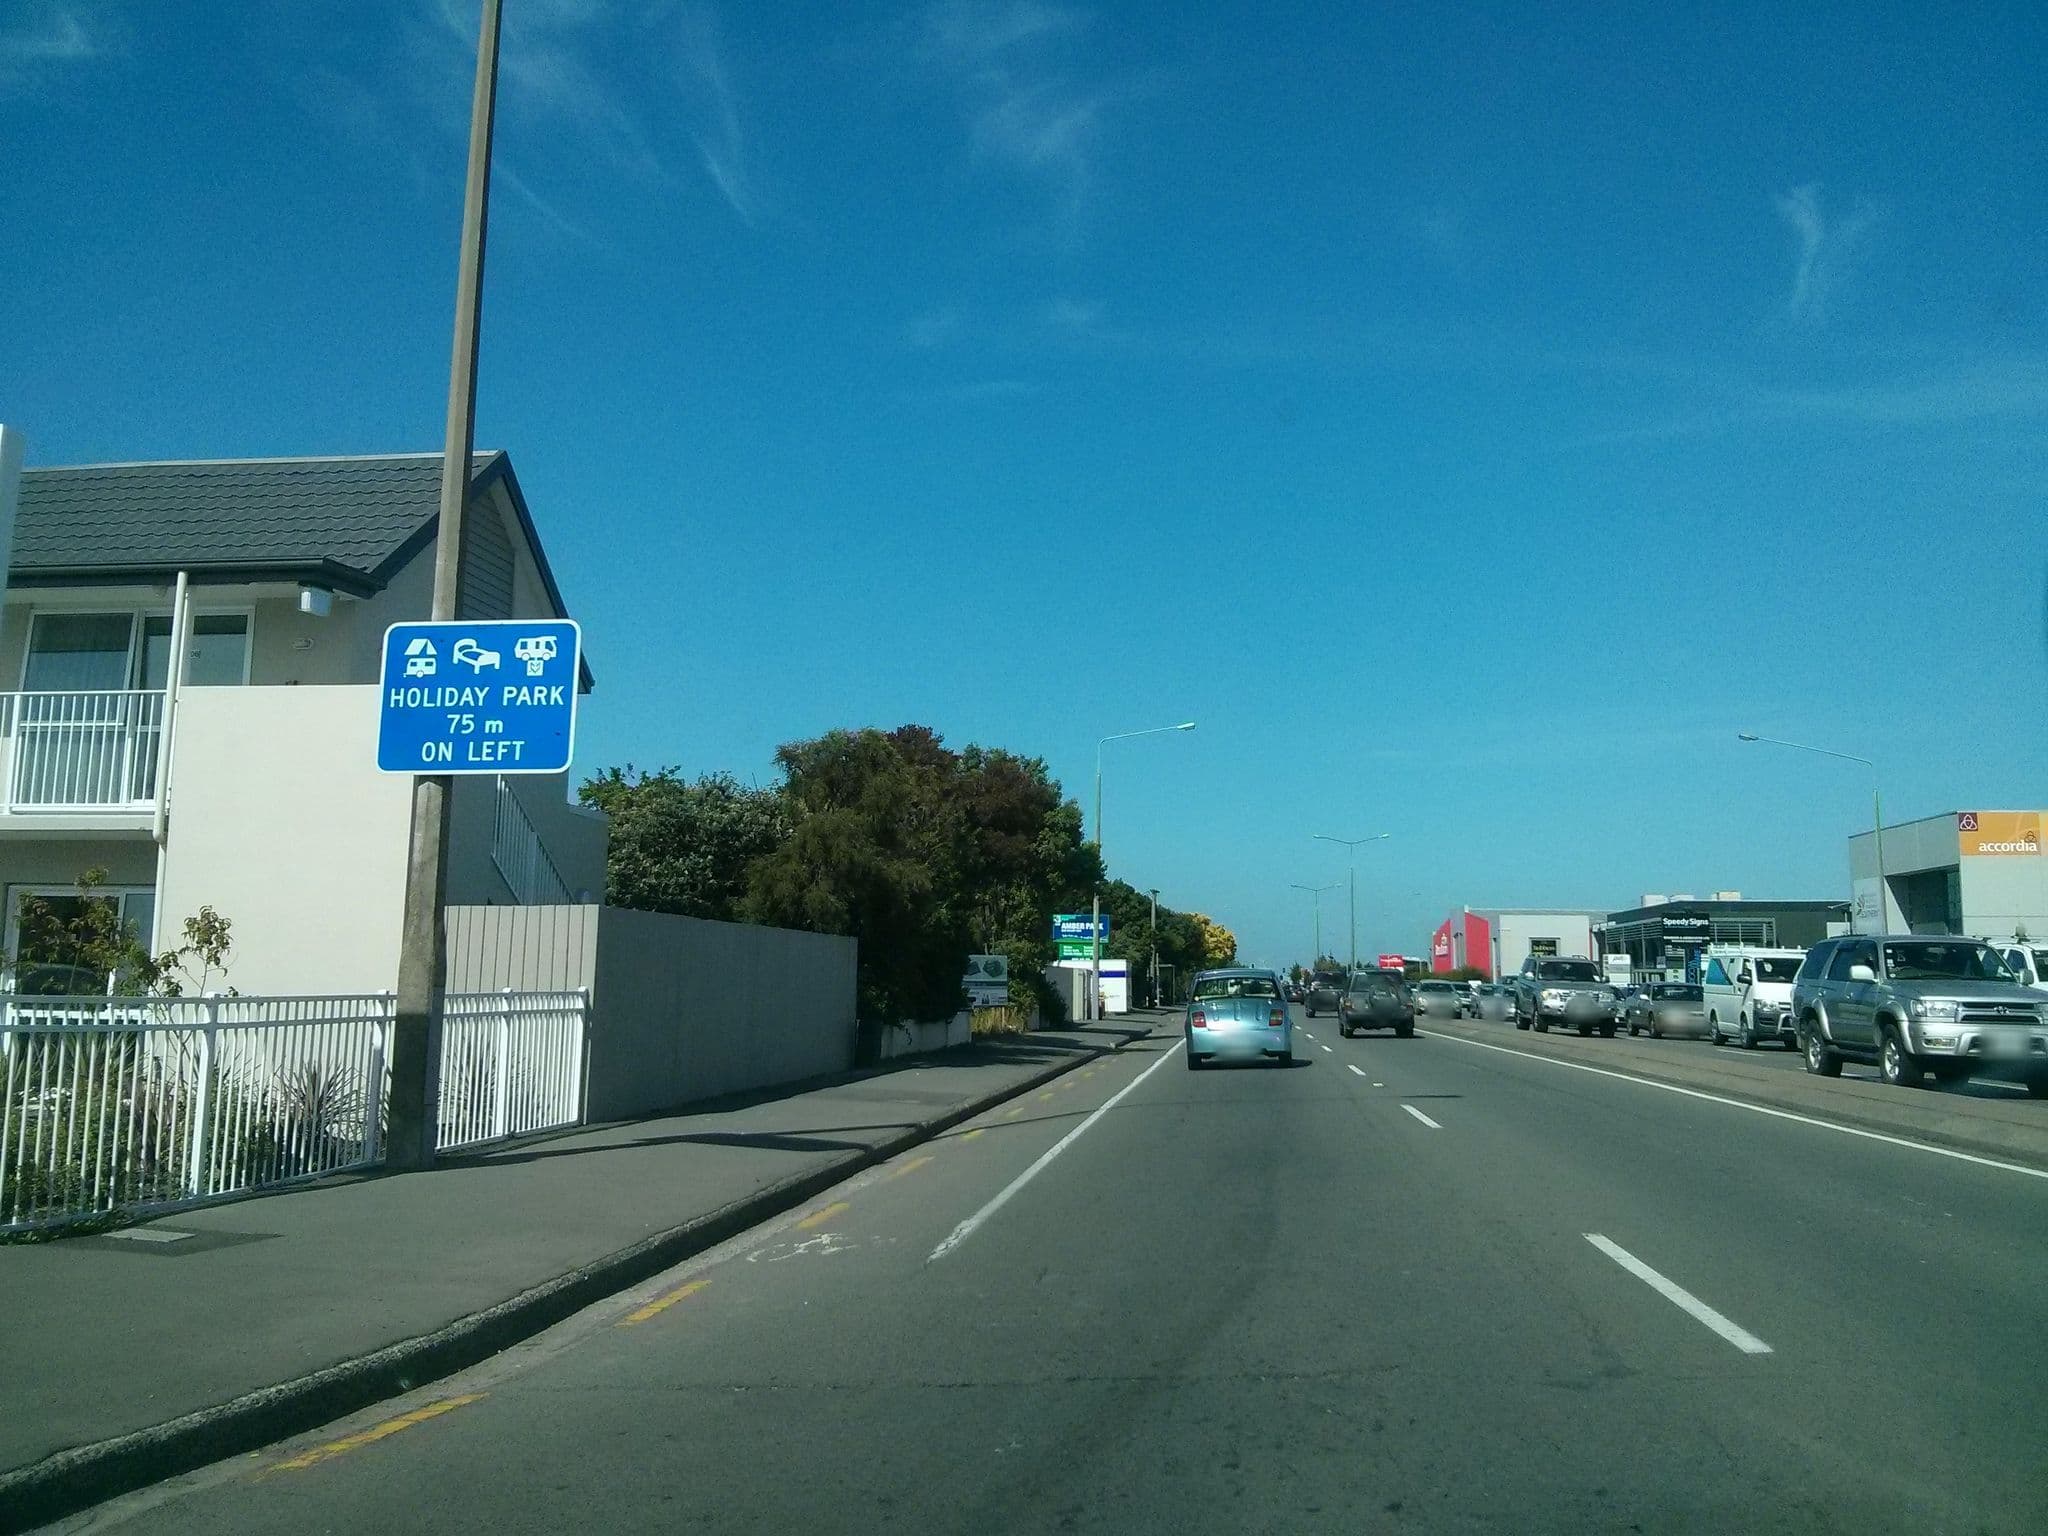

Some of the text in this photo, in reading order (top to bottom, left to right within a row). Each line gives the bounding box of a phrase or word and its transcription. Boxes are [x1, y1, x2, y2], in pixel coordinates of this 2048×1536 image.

[390, 685, 565, 708] HOLIDAY PARK
[446, 713, 504, 734] 75 m
[421, 740, 525, 762] ON LEFT
[1978, 839, 2038, 852] accordia
[1085, 922, 1104, 930] PAK
[1662, 917, 1709, 926] Speedy Signs
